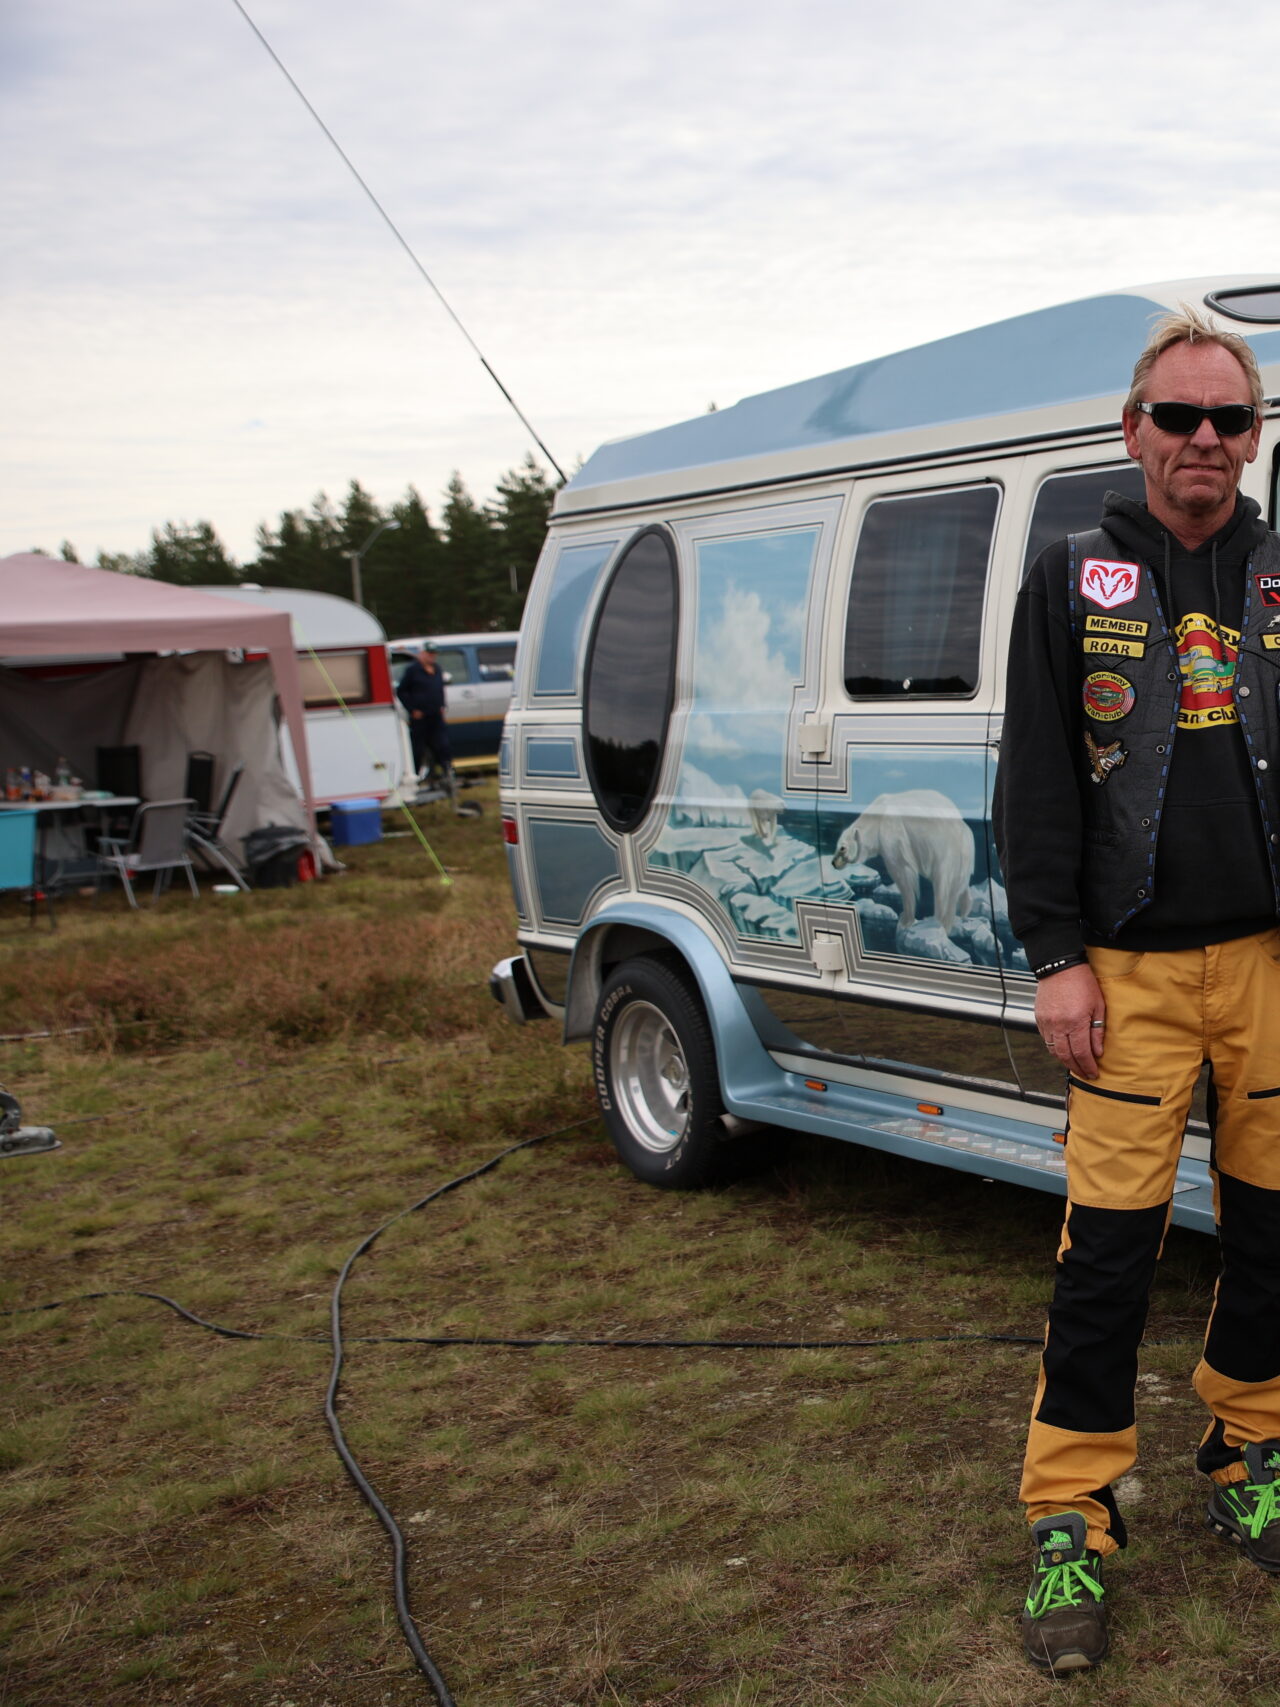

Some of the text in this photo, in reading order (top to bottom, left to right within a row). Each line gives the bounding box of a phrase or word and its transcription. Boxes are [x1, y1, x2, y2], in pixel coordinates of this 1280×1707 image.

[1090, 618, 1143, 634] MEMBER
[1090, 640, 1130, 655] ROAR
[1177, 712, 1199, 724] an
[594, 1026, 612, 1111] COOPER
